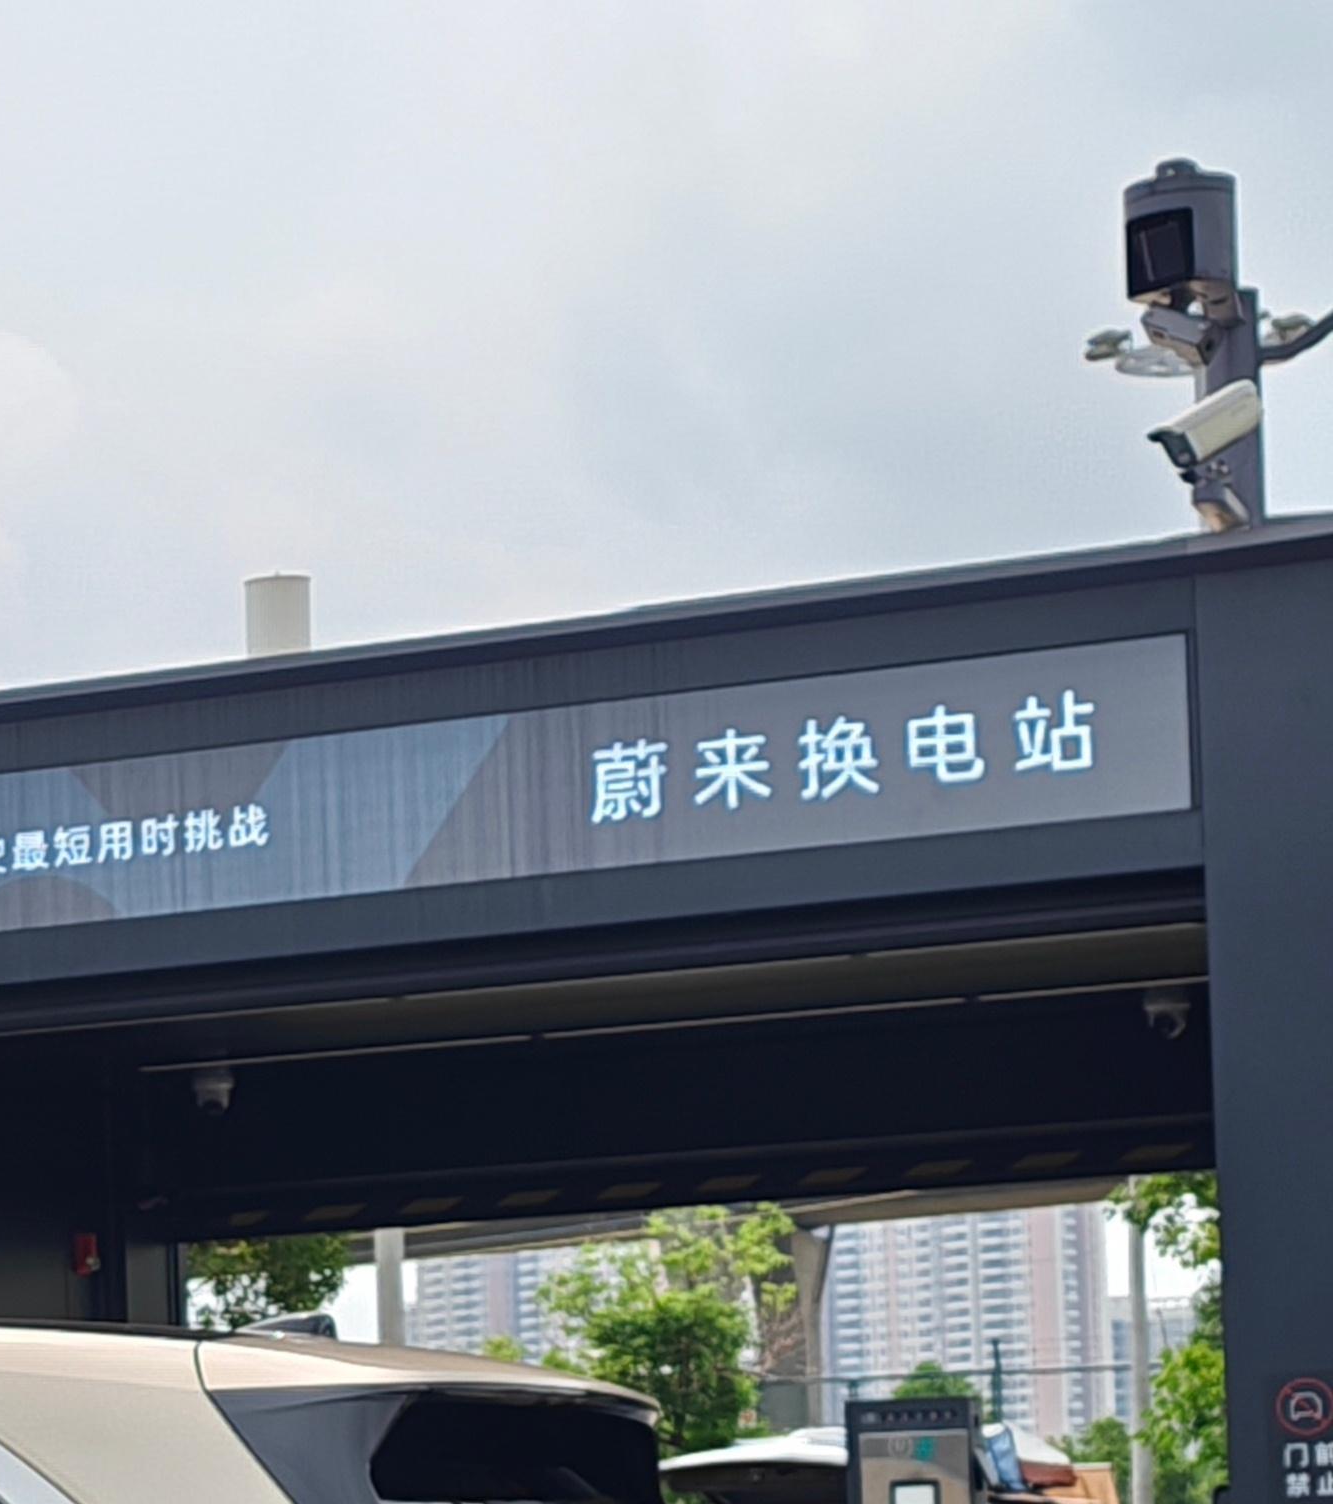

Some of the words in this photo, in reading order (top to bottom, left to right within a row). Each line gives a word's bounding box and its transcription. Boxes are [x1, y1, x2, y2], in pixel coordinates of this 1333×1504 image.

[590, 689, 1095, 824] 蔚来换电站
